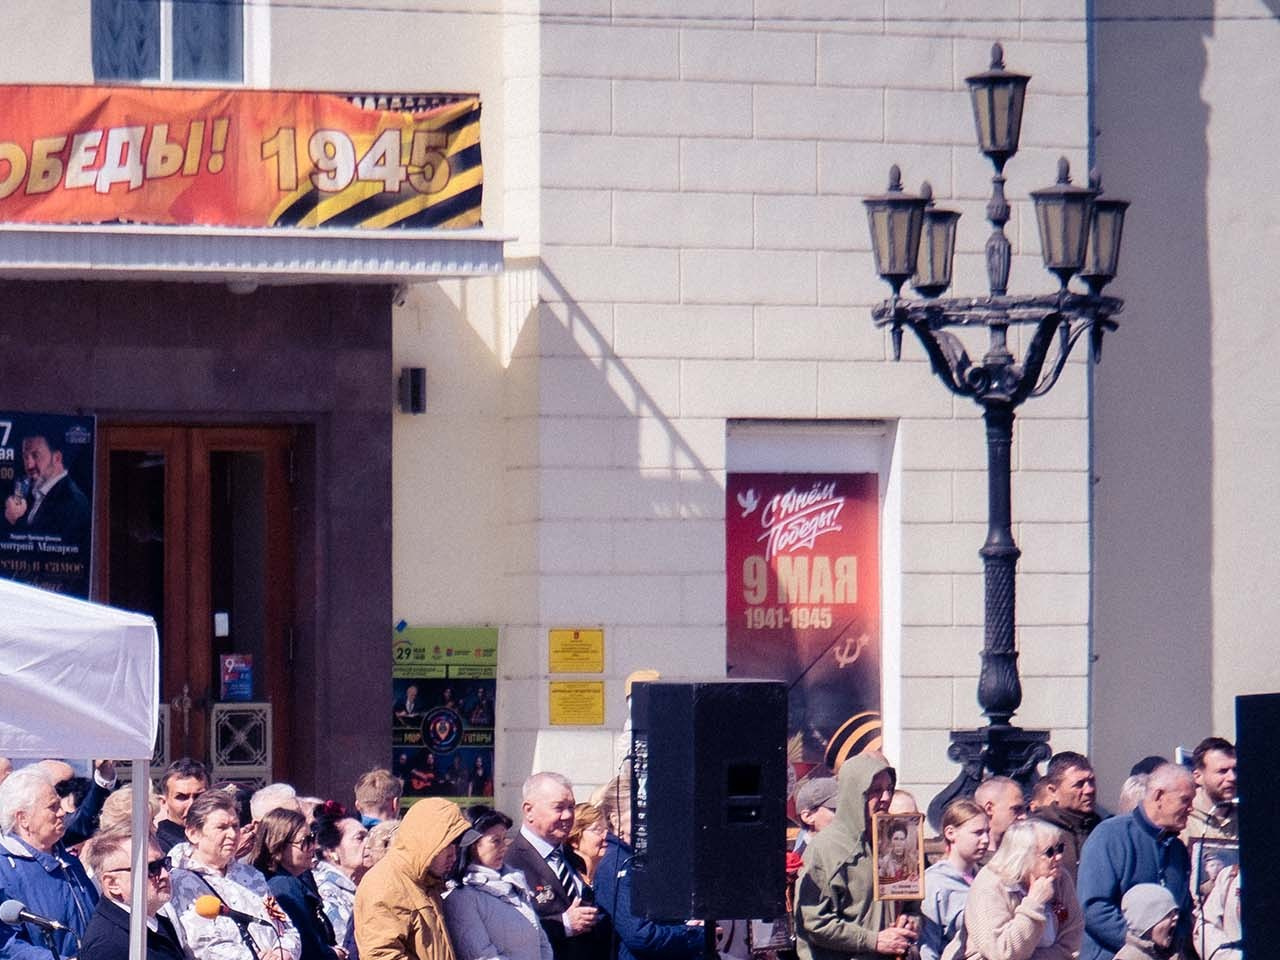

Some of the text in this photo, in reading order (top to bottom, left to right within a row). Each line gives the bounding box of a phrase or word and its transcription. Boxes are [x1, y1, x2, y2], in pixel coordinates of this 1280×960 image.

[260, 126, 452, 194] 1945
[742, 556, 857, 605] 9 МАЯ
[744, 607, 832, 629] 1941-1945
[396, 648, 411, 660] 29
